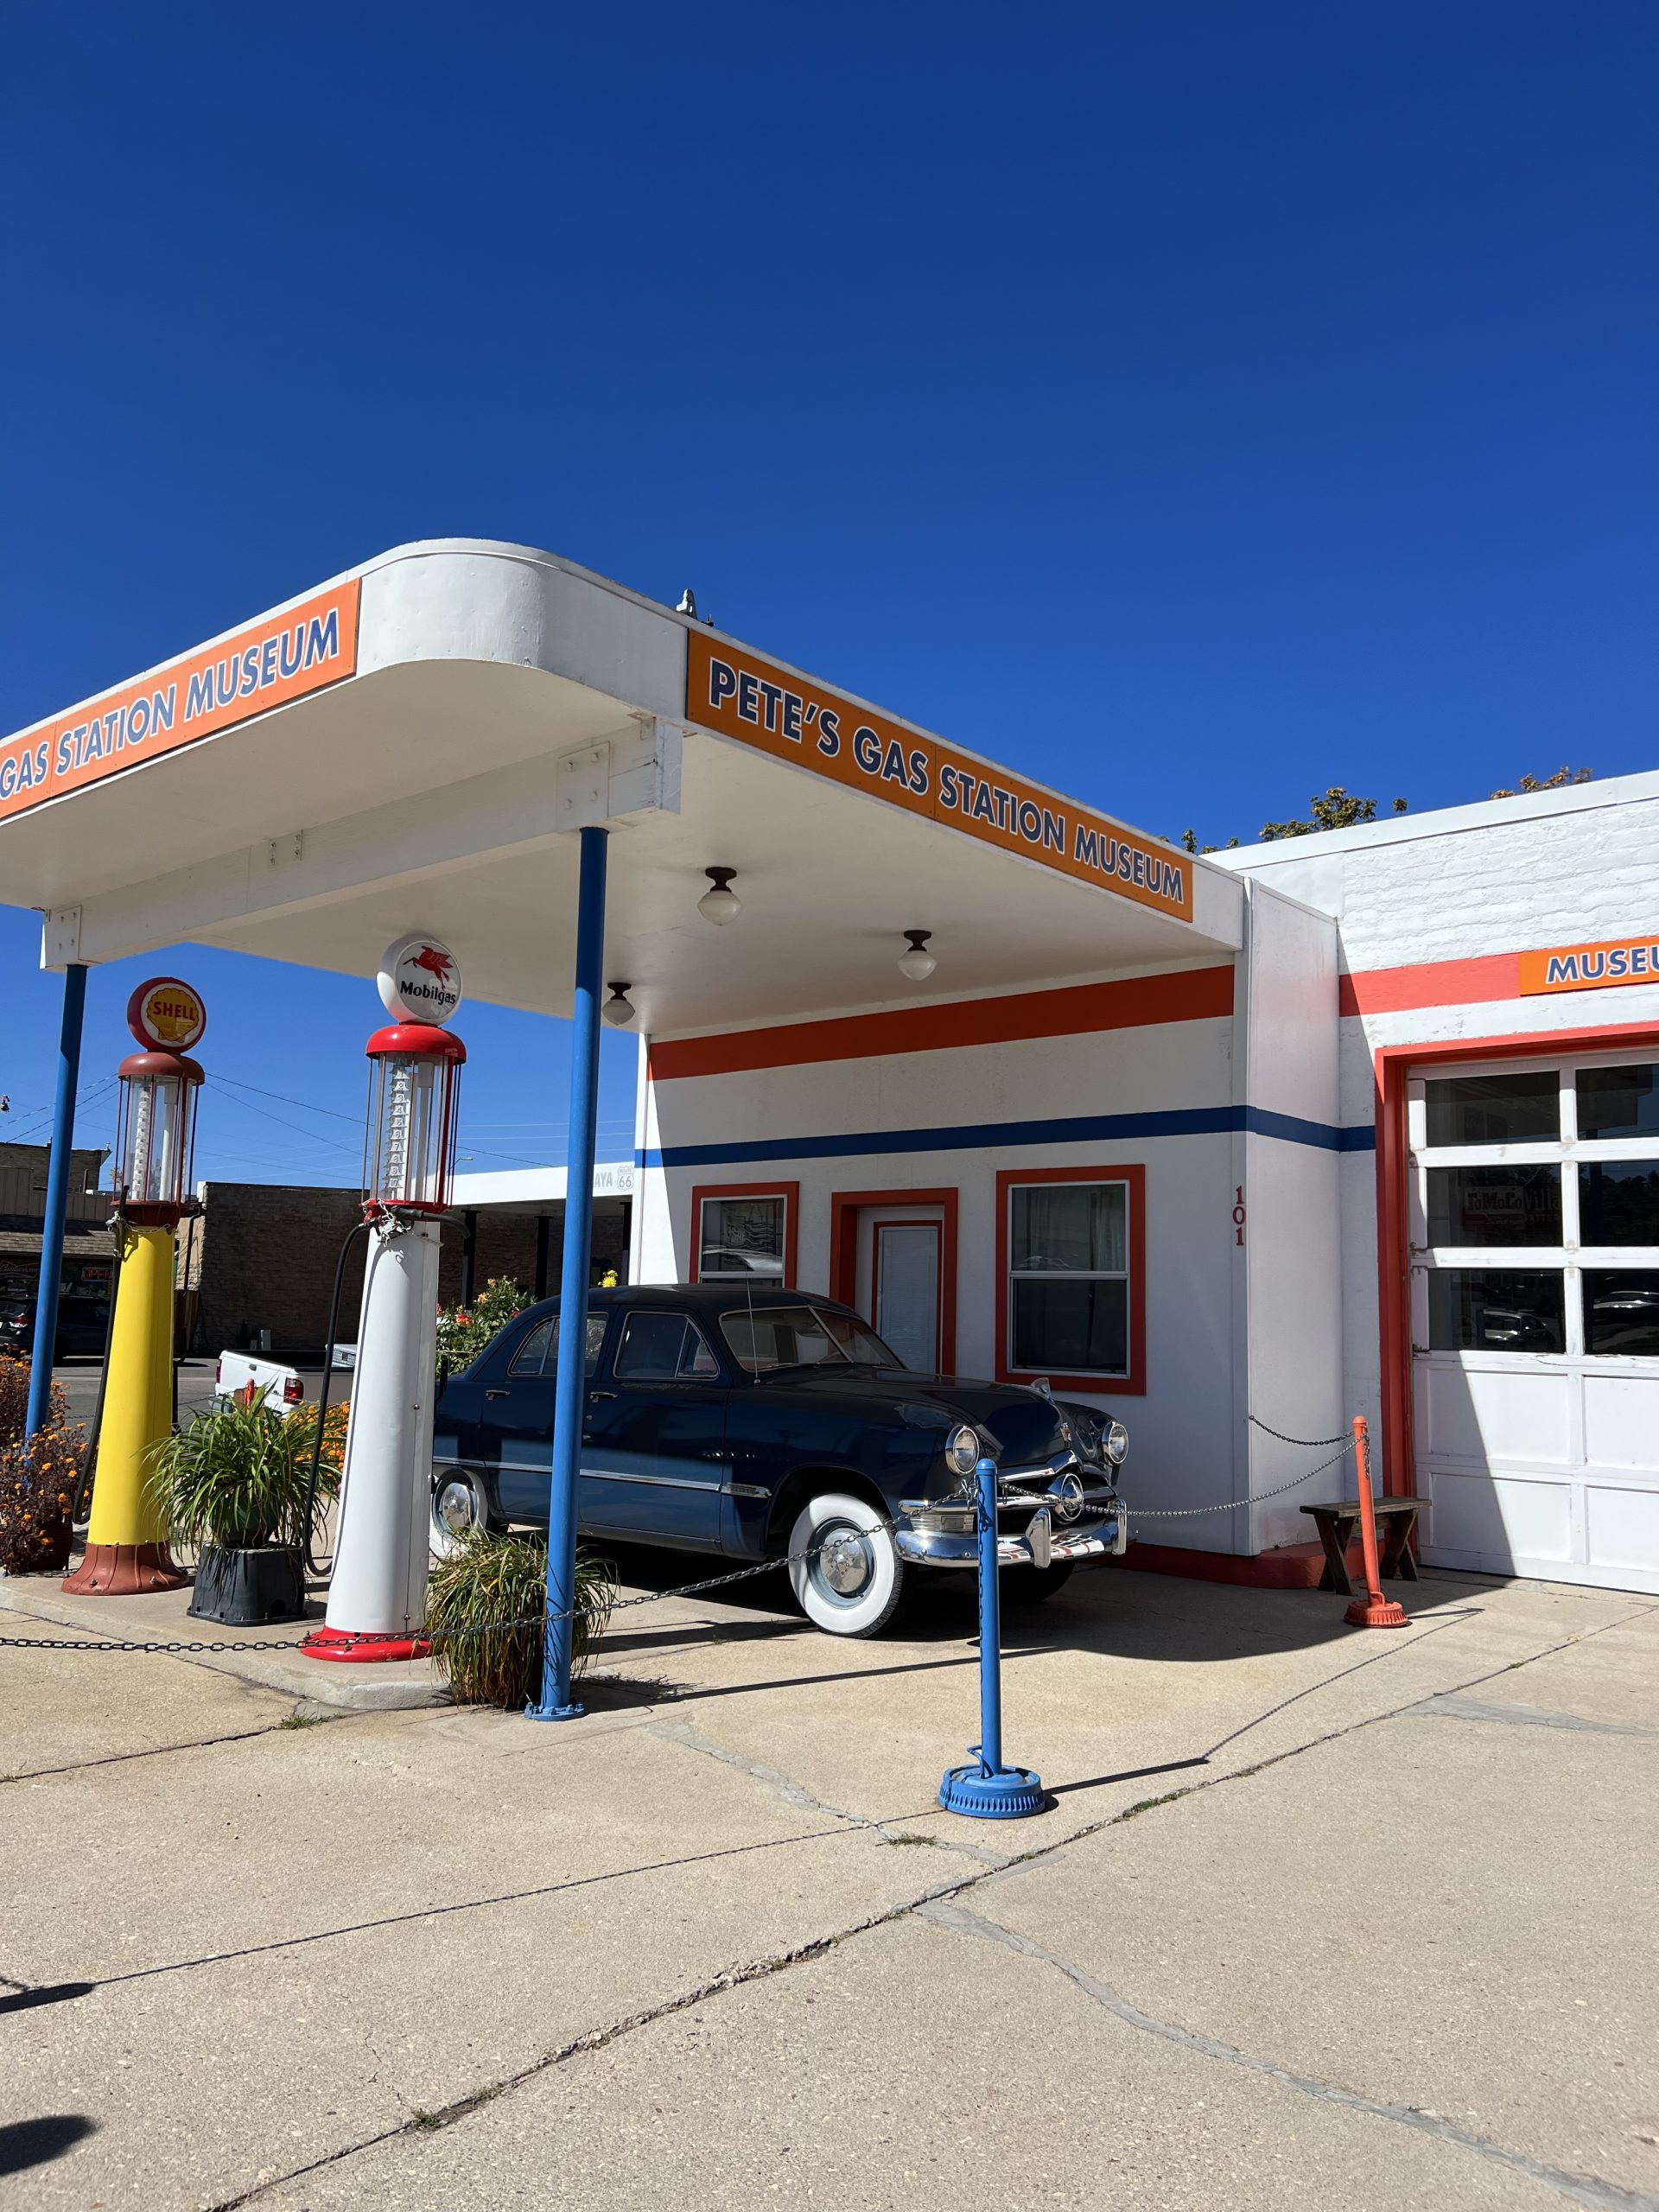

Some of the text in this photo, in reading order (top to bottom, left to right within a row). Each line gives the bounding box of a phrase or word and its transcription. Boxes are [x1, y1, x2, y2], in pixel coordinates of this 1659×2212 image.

[0, 607, 340, 800] GAS STATION MUSEUM
[709, 657, 1184, 905] PETE'S GAS STATION MUSEUM
[400, 981, 456, 1005] Mobilgas
[153, 1001, 196, 1021] SHELL
[619, 1175, 632, 1188] 66
[1232, 1185, 1246, 1246] 101
[82, 1268, 114, 1280] OPEN
